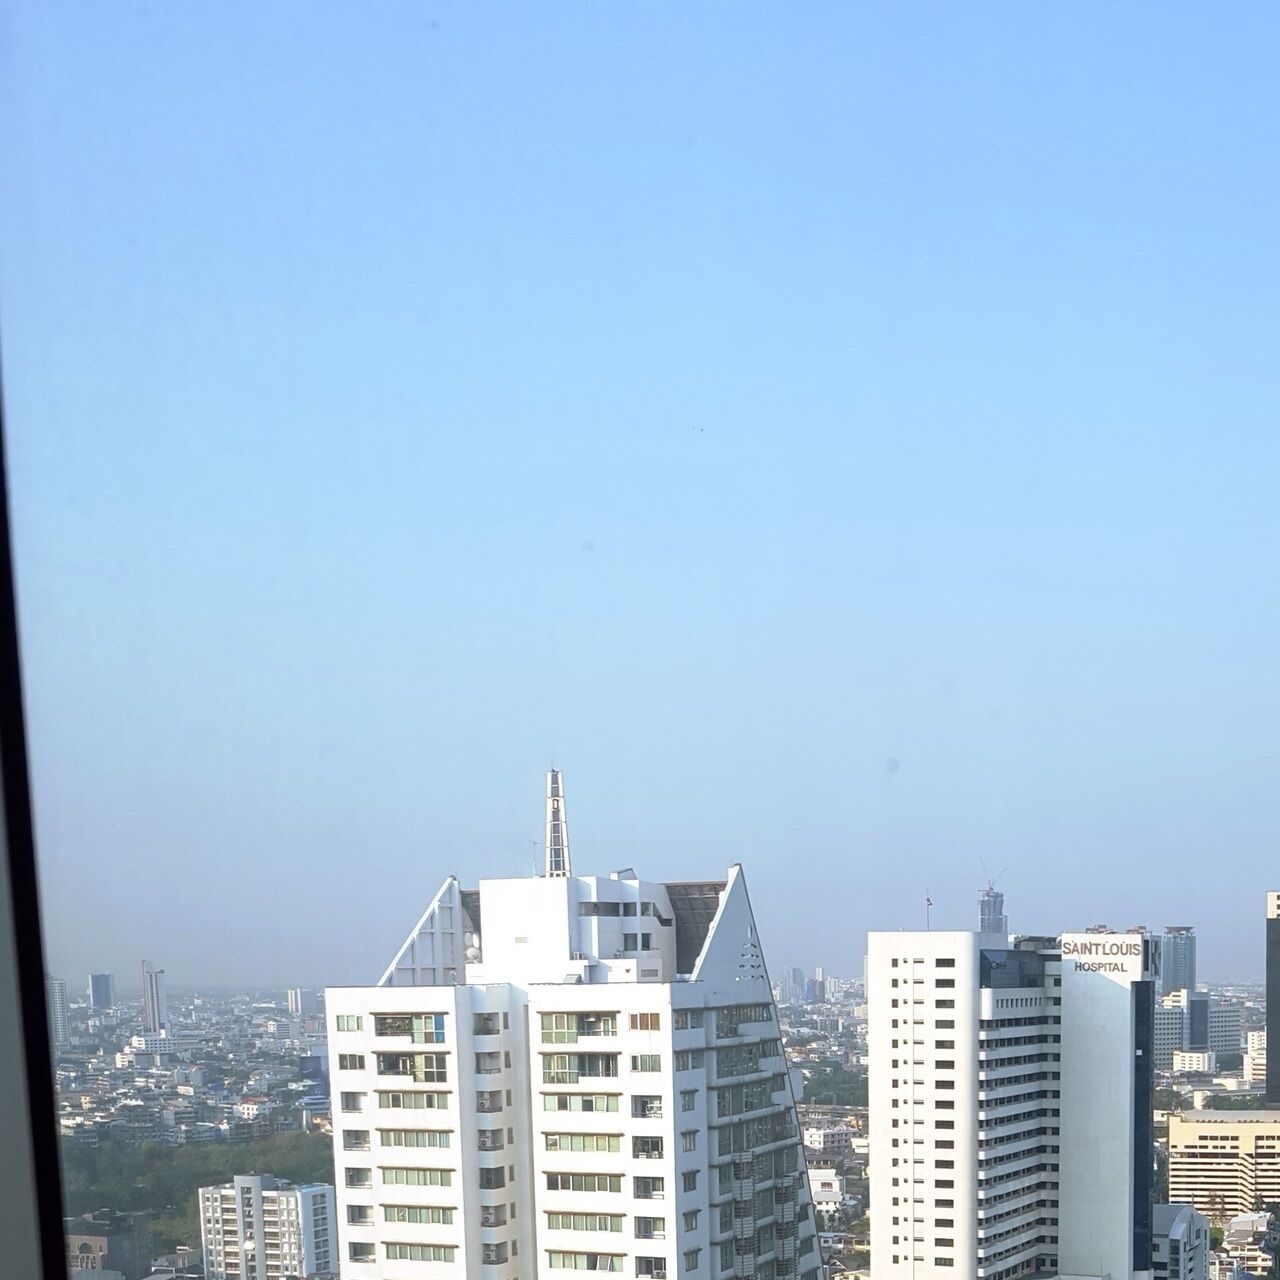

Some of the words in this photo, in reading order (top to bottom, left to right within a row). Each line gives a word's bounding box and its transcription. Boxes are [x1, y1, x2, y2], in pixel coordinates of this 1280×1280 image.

[1063, 942, 1101, 955] SAINT
[1102, 942, 1141, 956] LOUIS
[1075, 962, 1128, 972] HOSPITAL
